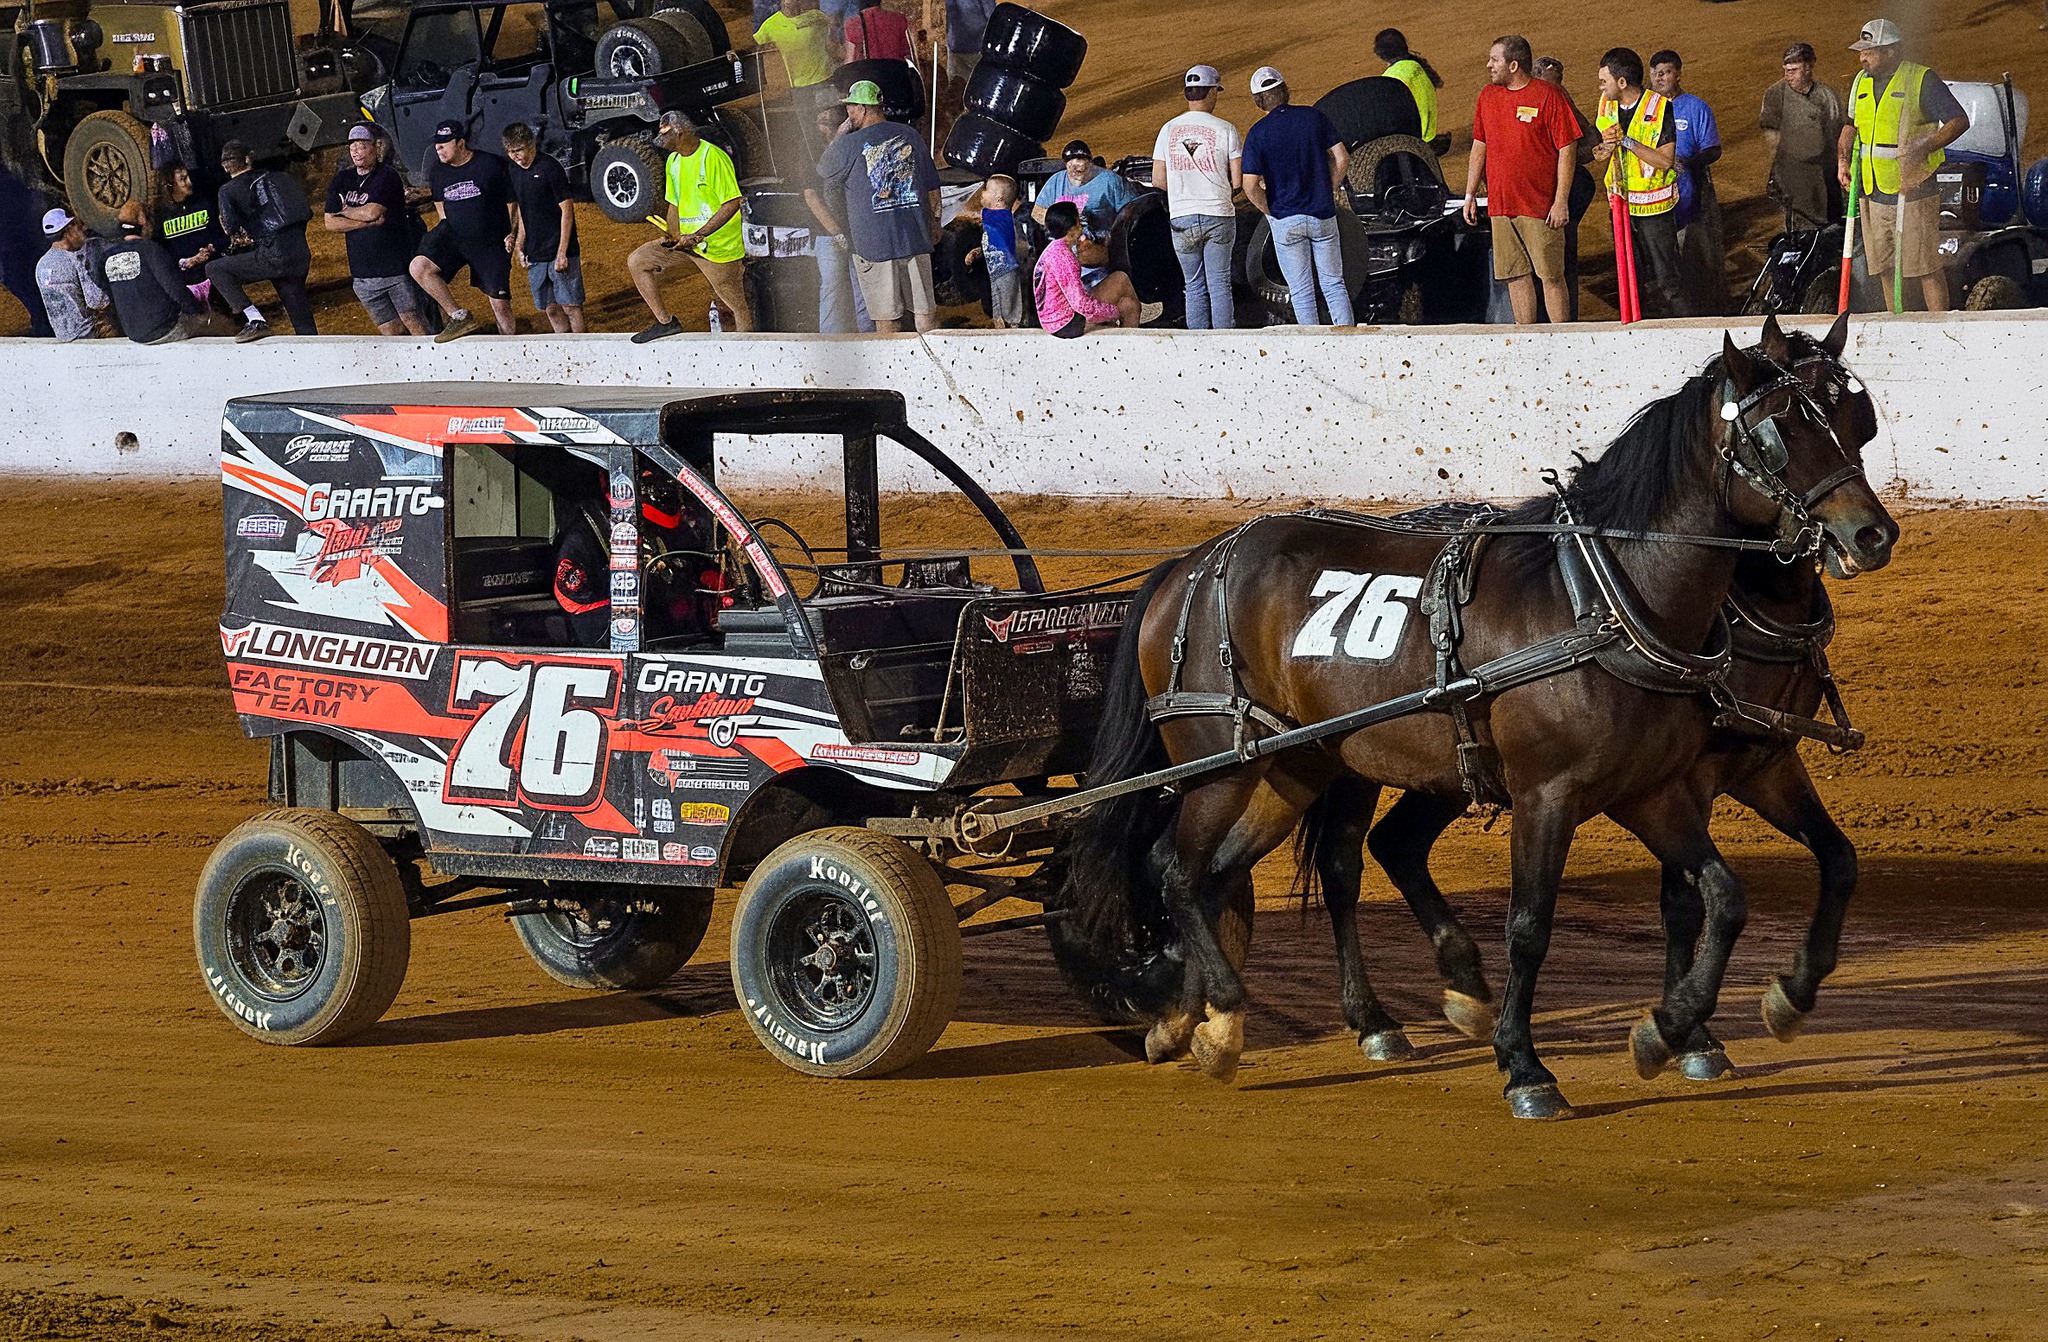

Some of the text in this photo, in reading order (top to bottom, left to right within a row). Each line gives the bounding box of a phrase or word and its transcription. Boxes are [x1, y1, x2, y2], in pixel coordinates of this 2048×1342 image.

[1291, 569, 1424, 660] 76
[247, 626, 435, 676] LONGHORN
[233, 669, 380, 703] FACTORY
[251, 690, 341, 719] TEAM
[449, 657, 615, 799] 76
